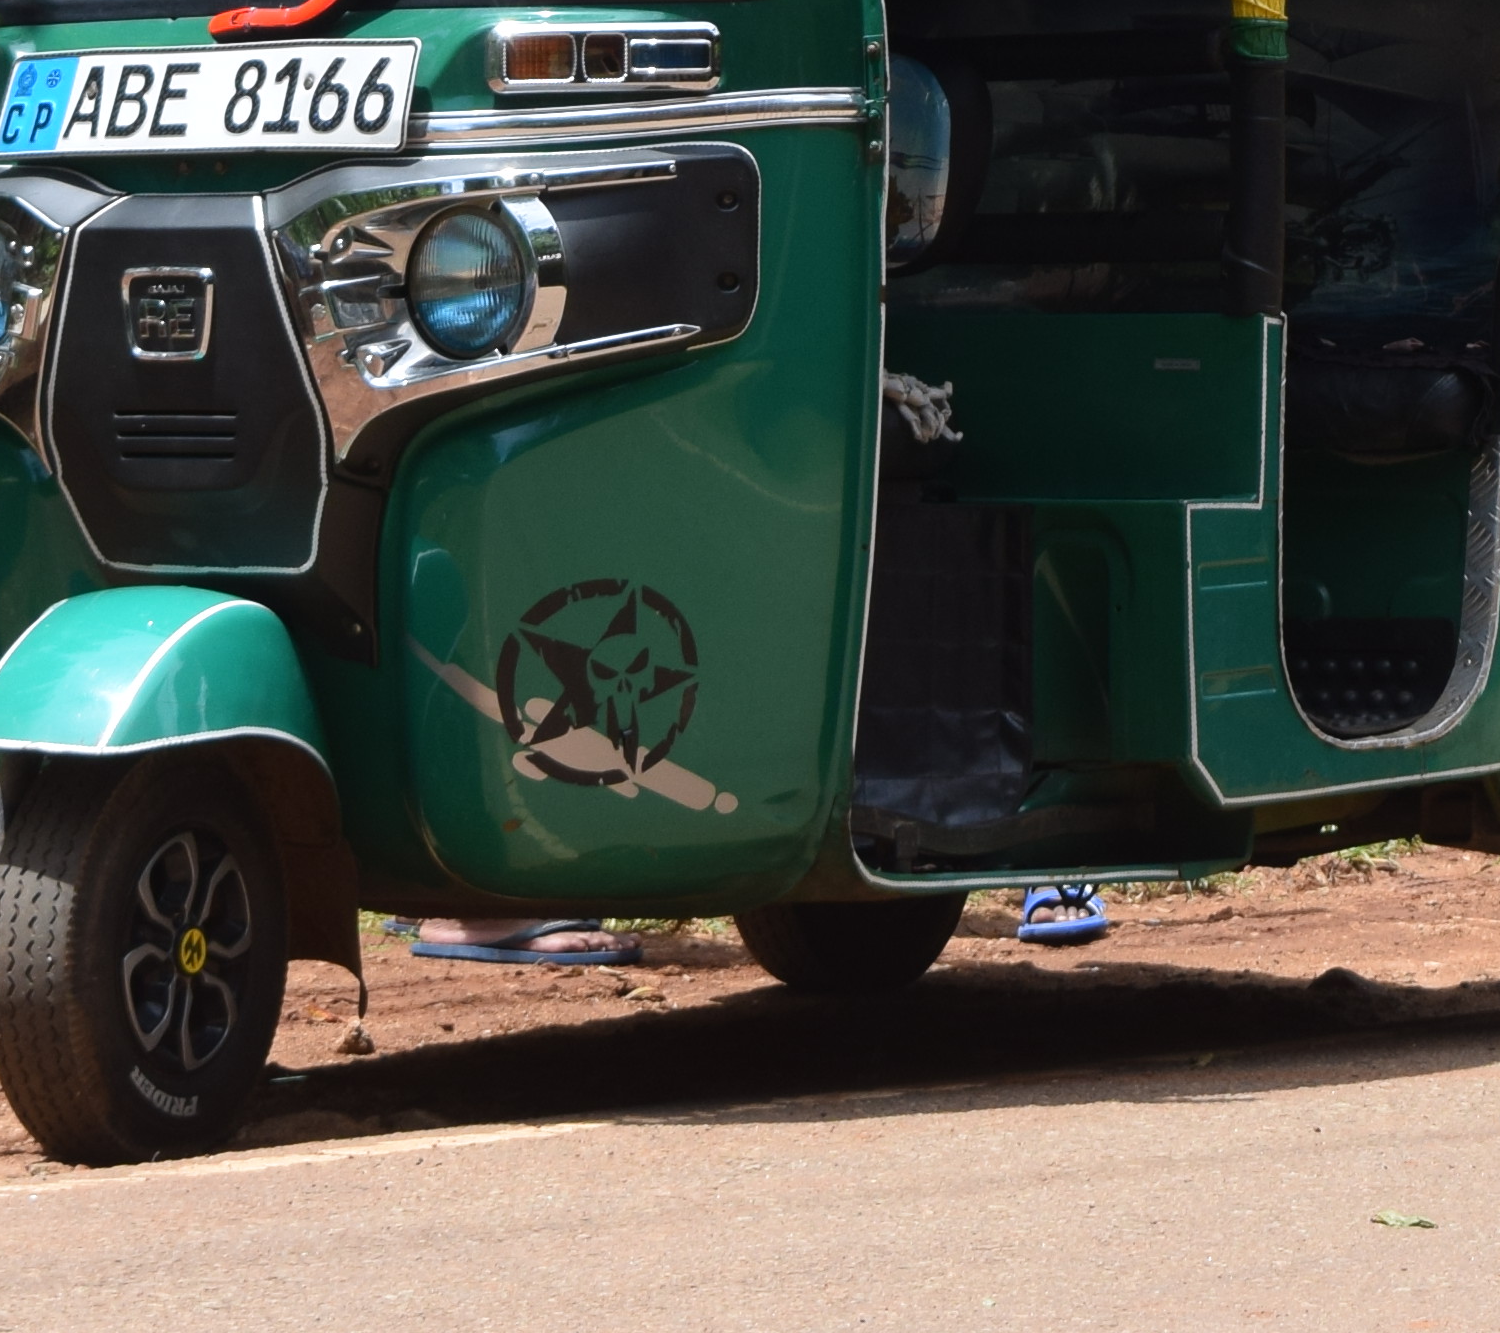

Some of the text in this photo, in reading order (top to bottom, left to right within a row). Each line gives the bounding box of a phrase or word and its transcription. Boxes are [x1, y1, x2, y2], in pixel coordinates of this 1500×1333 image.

[62, 62, 202, 140] ABE
[223, 56, 396, 135] 8166
[138, 298, 196, 338] RE
[130, 1064, 199, 1117] PRIDER
